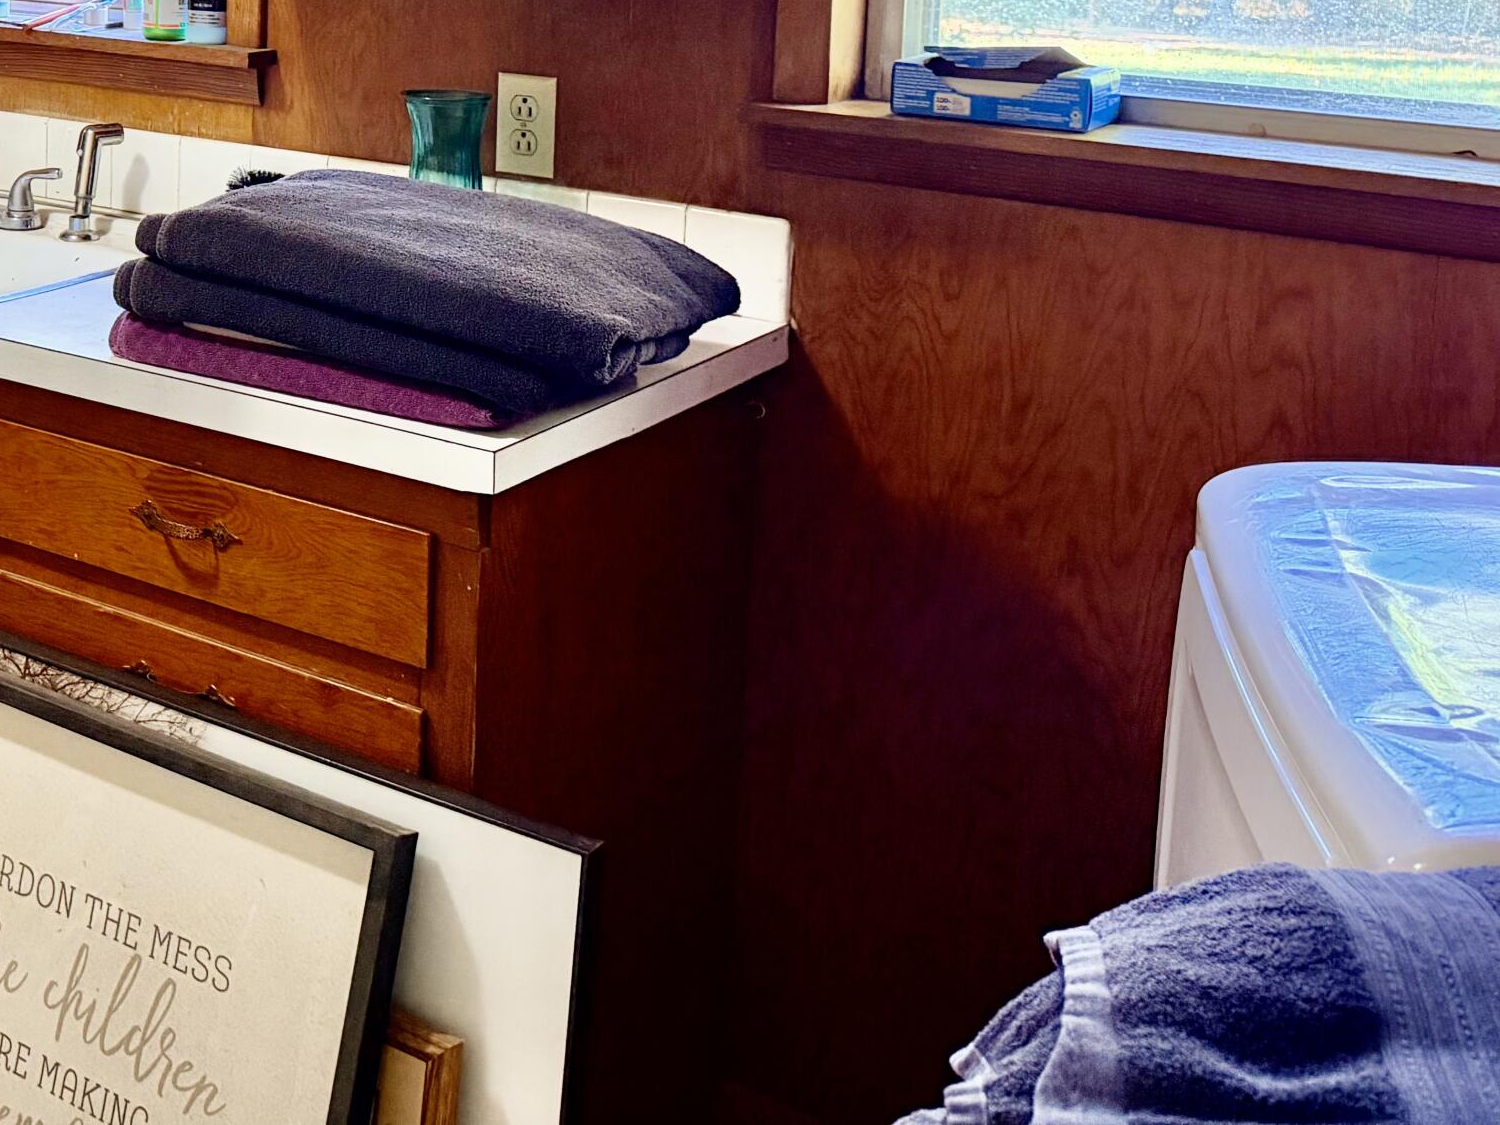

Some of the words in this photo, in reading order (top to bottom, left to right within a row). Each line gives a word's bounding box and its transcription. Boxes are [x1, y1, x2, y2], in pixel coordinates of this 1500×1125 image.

[85, 893, 142, 950] THE
[148, 924, 232, 993] MESS
[43, 943, 226, 1116] children
